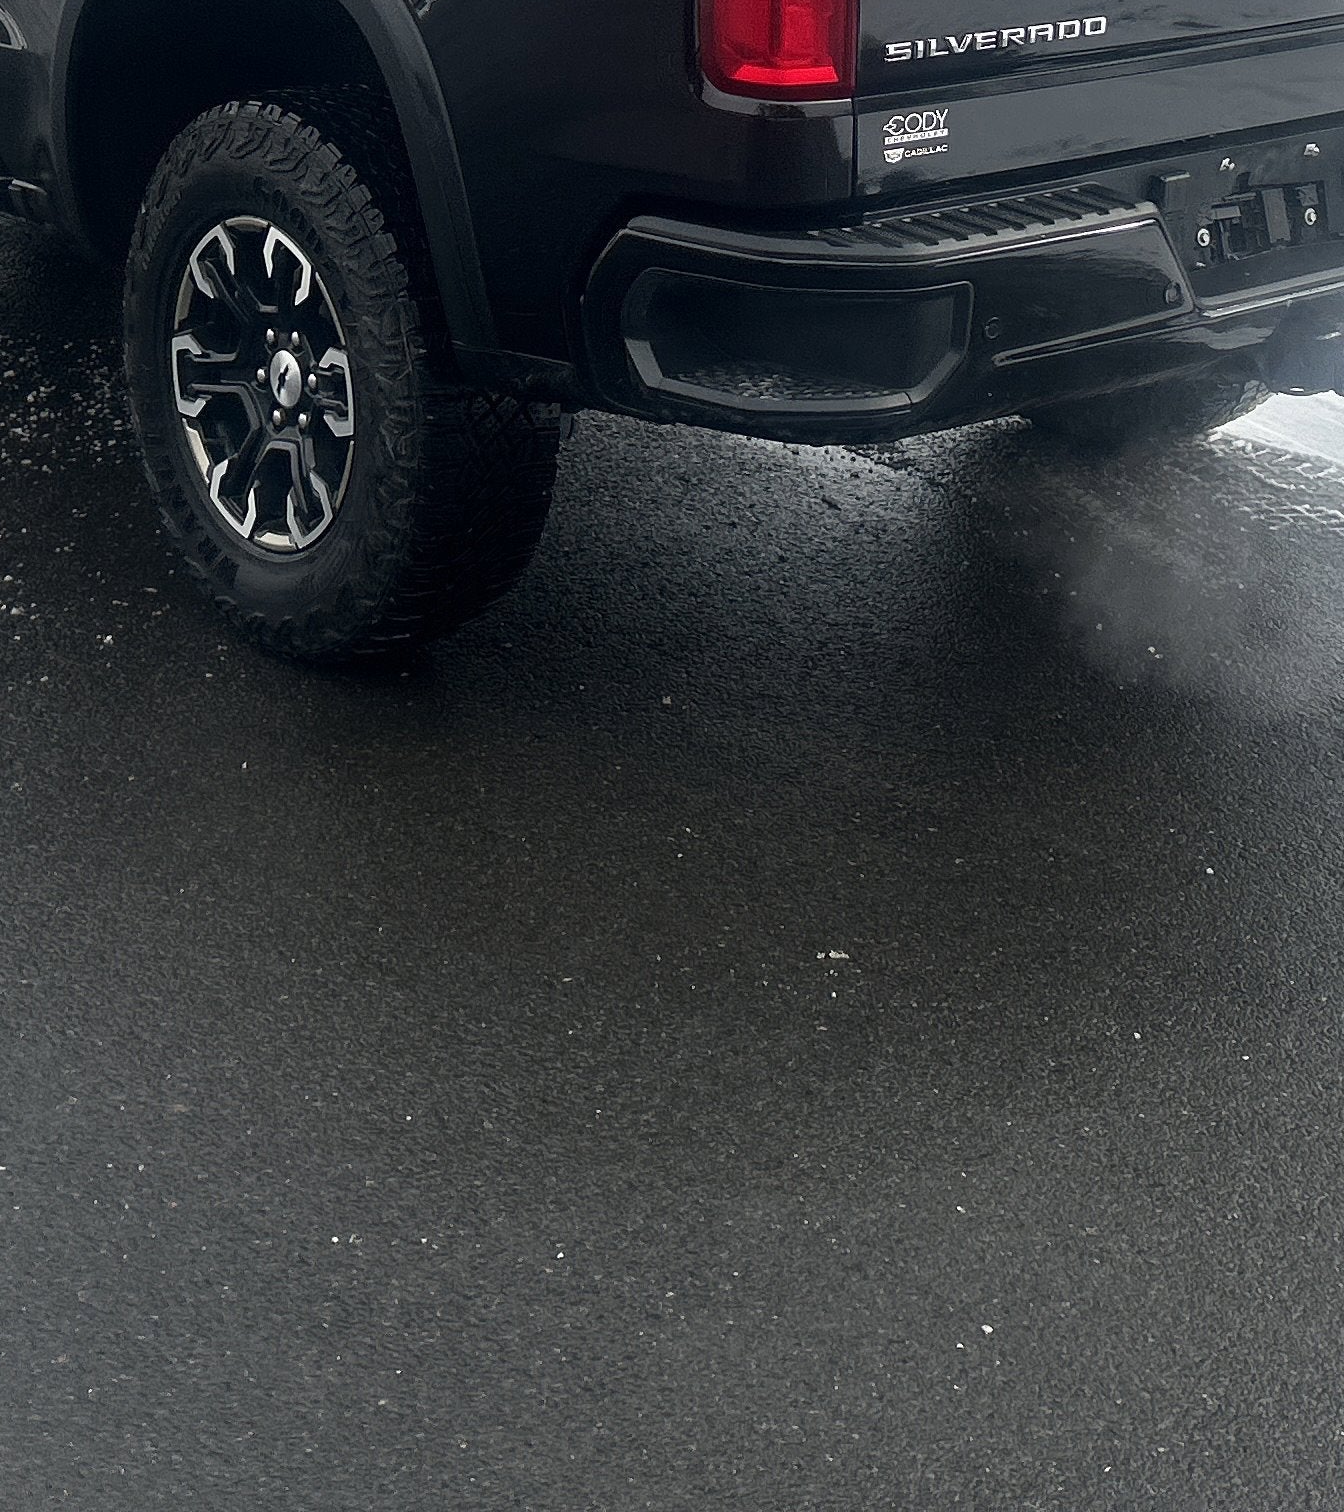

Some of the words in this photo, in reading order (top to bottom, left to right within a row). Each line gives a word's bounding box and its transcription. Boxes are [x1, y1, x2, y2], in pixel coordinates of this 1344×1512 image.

[883, 15, 1108, 63] SILVERADO
[882, 108, 949, 136] CODY
[904, 144, 948, 158] CADILLAC
